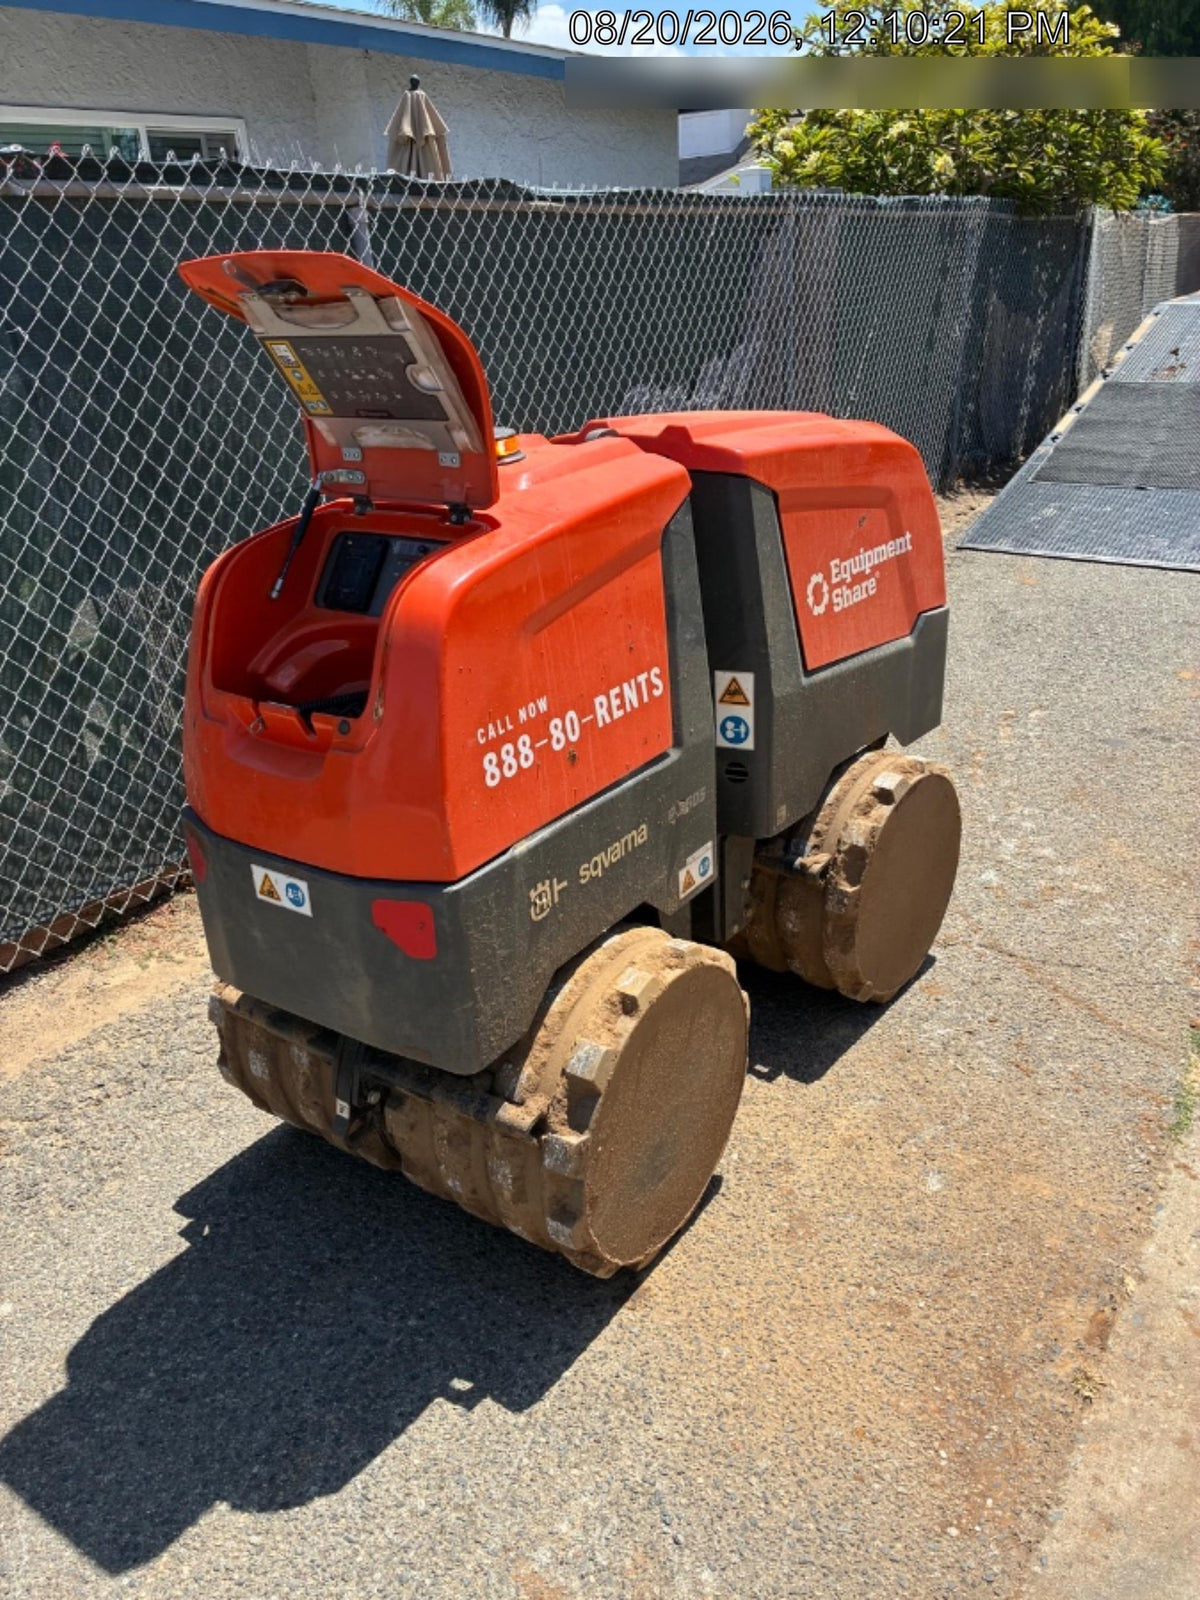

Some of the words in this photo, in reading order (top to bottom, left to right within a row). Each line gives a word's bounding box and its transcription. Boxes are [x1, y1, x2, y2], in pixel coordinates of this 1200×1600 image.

[830, 531, 912, 583] Equipment
[476, 715, 514, 744] CALL
[518, 696, 548, 723] NOW
[482, 665, 665, 788] 888-80-RENTS
